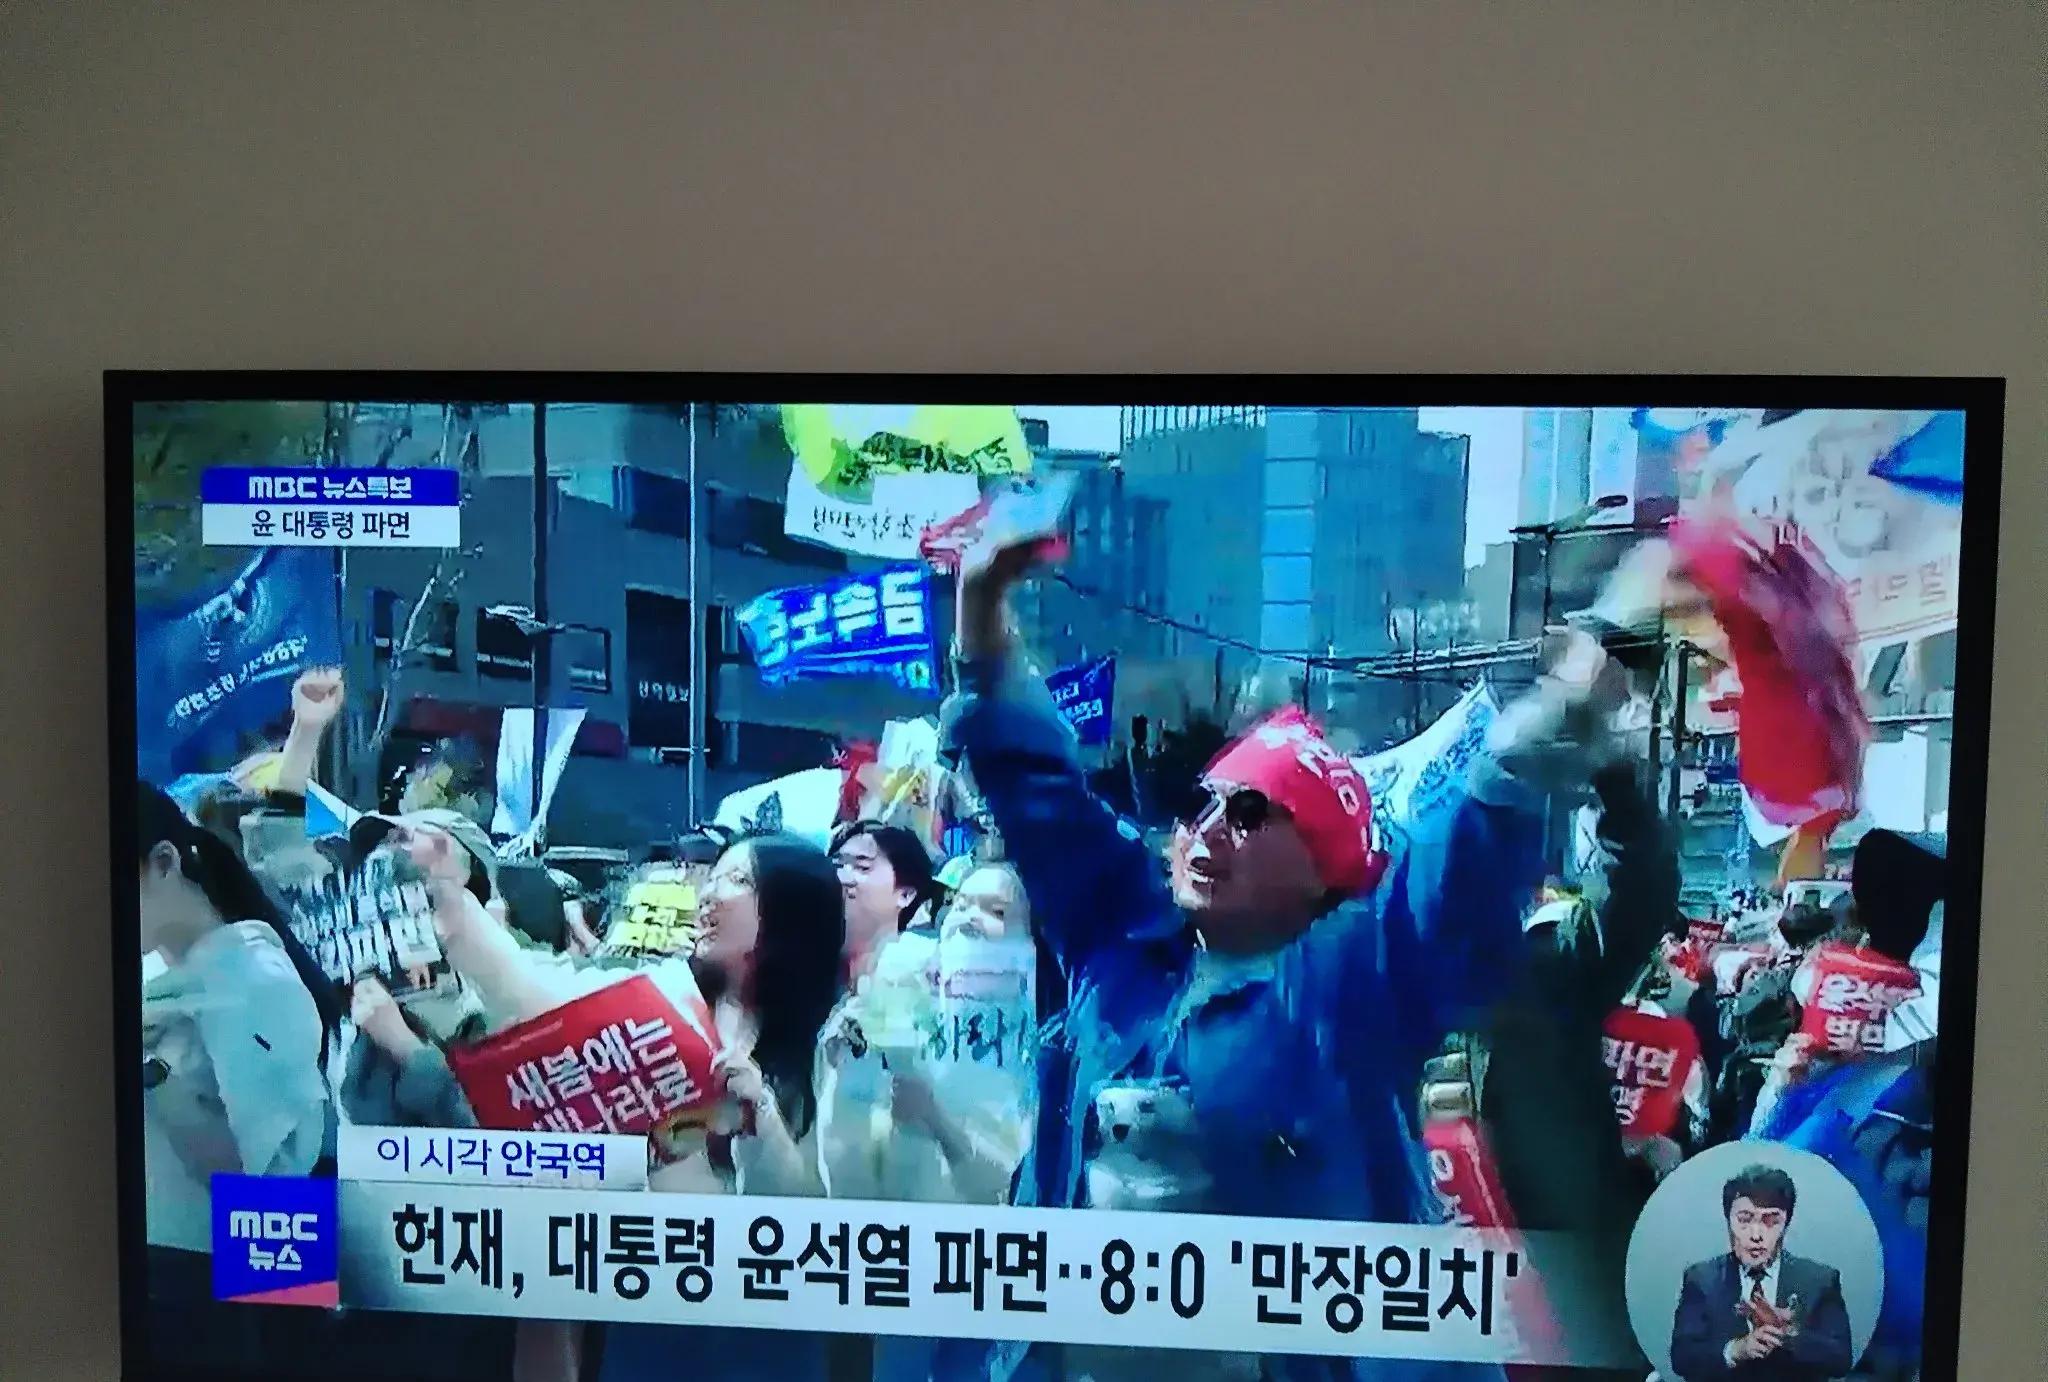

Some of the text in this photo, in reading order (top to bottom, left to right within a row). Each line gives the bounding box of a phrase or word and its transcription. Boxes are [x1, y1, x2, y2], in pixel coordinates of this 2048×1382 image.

[249, 476, 413, 500] MBC 뉴스특보
[252, 509, 410, 539] 윤 대통령 파면
[377, 1135, 605, 1181] 이 시각 안국역
[230, 1210, 319, 1241] MBC
[249, 1242, 303, 1271] 뉴스
[392, 1203, 525, 1299] 헌재,
[548, 1212, 715, 1303] 대통령
[737, 1215, 910, 1308] 윤석열
